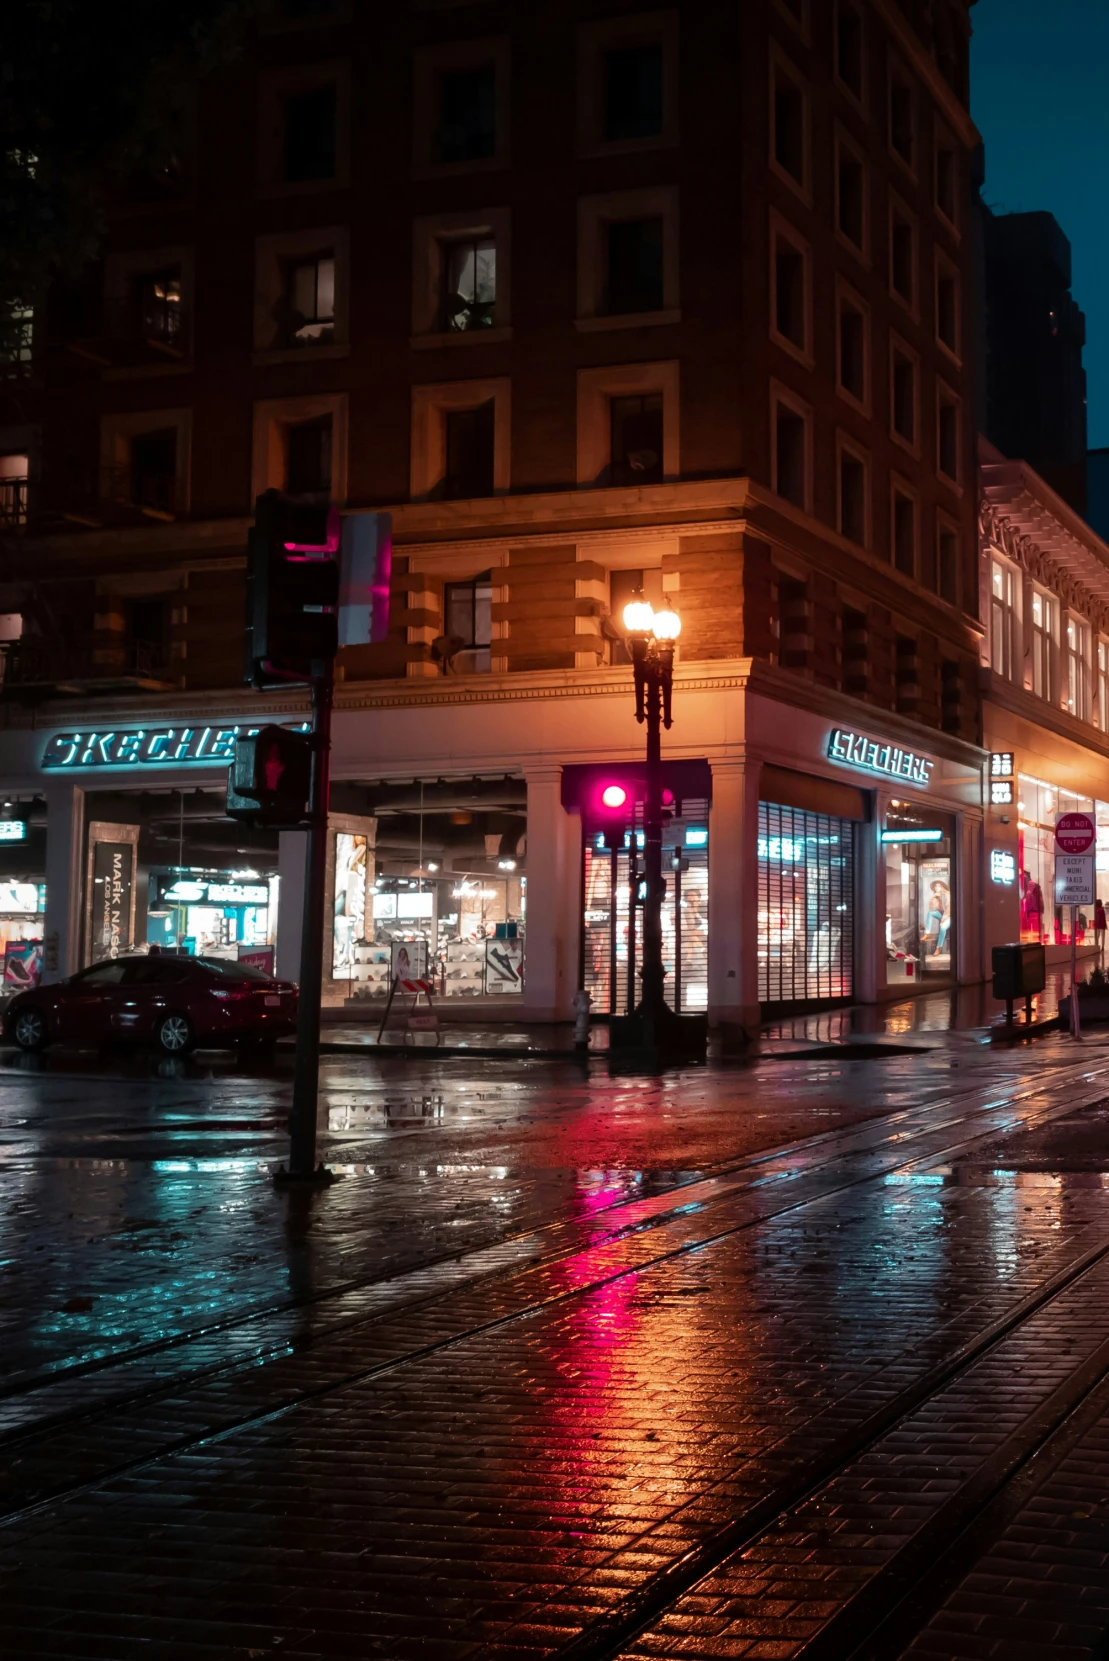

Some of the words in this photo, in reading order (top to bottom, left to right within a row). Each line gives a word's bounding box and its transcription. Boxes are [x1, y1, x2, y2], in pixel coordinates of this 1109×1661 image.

[829, 729, 935, 785] SKECHERS
[1074, 820, 1089, 828] NOT
[1063, 839, 1086, 847] ENTER
[111, 853, 122, 904] MARK
